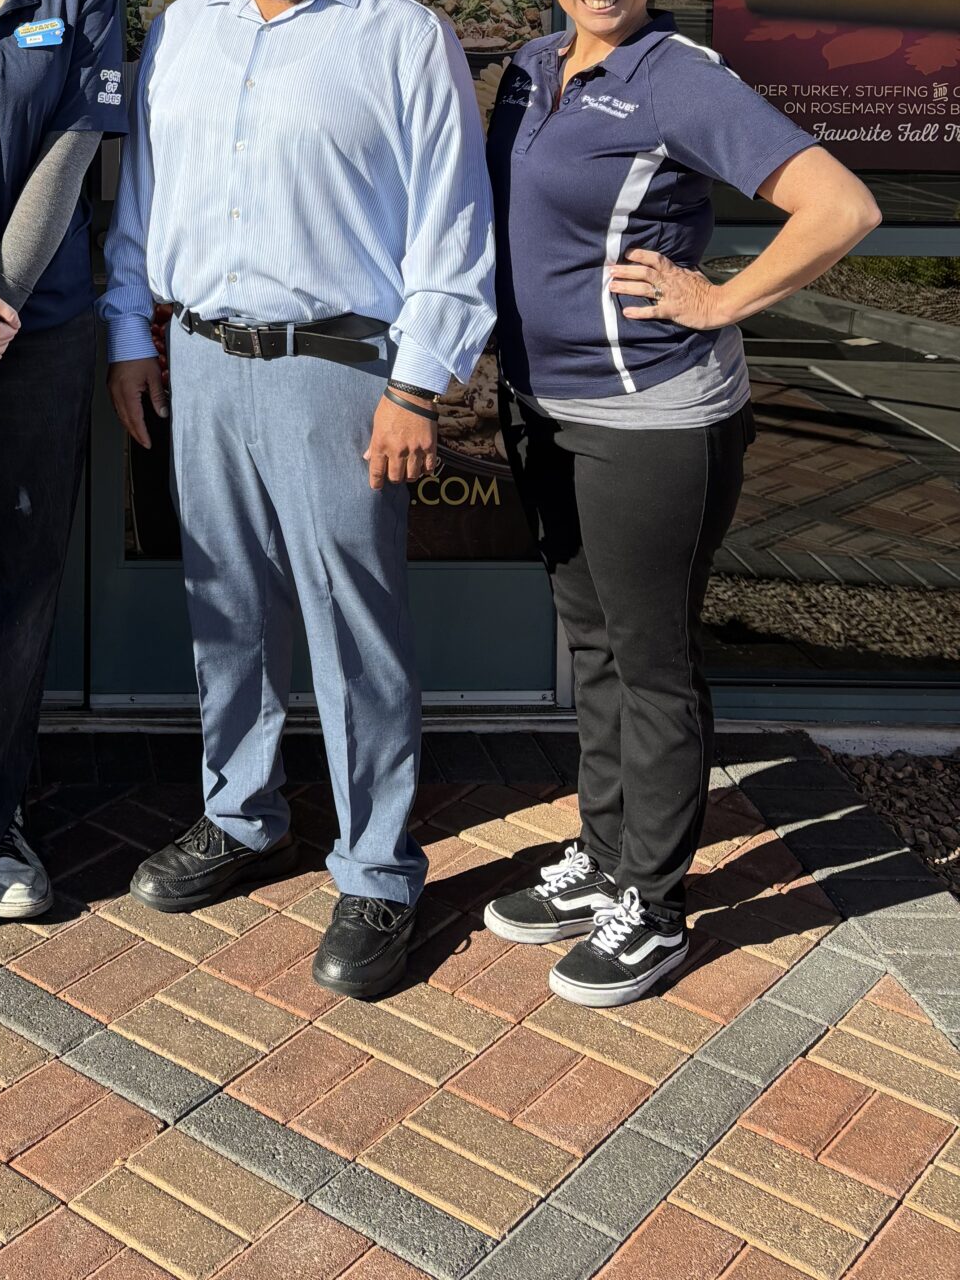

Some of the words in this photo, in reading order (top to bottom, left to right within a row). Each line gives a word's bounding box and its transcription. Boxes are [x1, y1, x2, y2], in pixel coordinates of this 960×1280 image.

[792, 84, 852, 99] TURKEY,
[855, 85, 929, 98] STUFFING
[783, 101, 807, 115] ON
[810, 101, 895, 115] ROSEMARY
[897, 103, 947, 116] SWISS
[812, 121, 894, 143] Favorite
[897, 122, 940, 143] Fall
